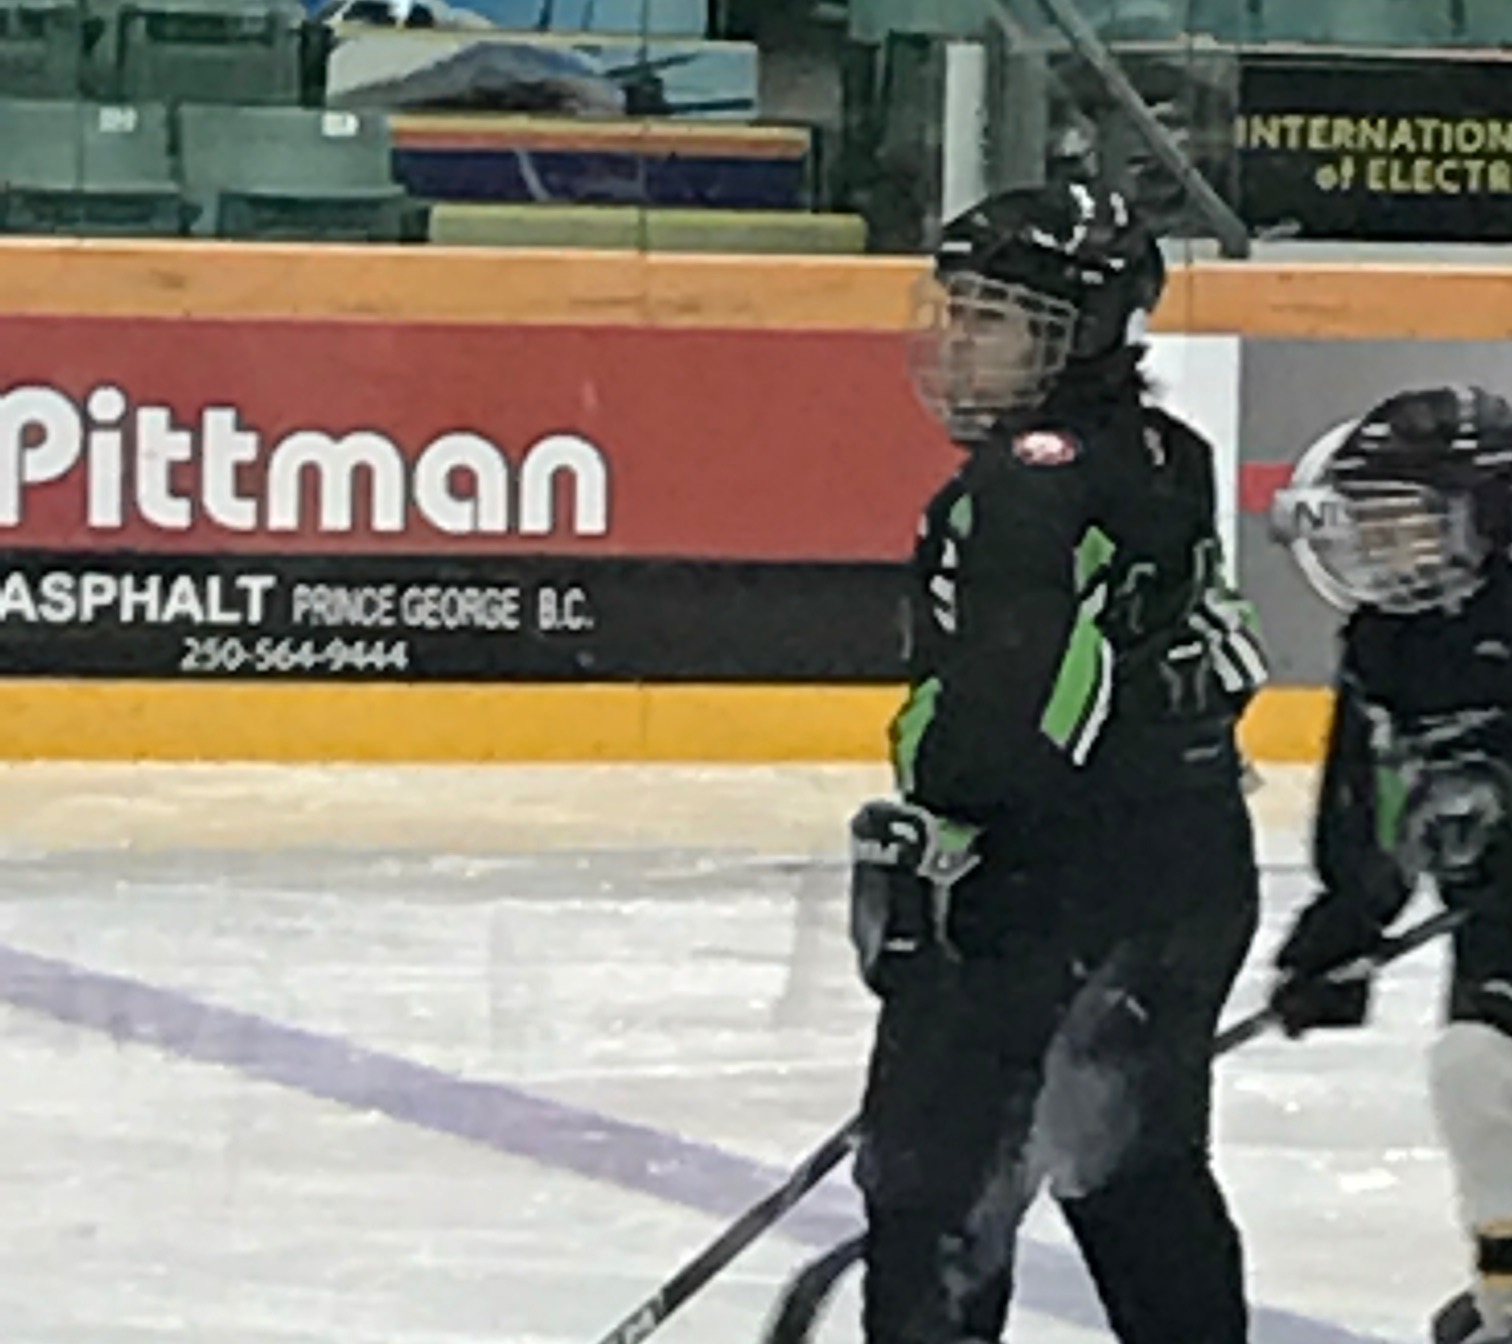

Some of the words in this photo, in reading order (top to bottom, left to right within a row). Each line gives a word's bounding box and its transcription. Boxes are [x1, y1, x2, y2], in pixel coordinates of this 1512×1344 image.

[1314, 160, 1355, 191] of
[0, 386, 608, 536] Pittman
[0, 573, 276, 625] ASPHALT
[291, 584, 397, 628] PRINCE
[402, 586, 521, 630] GEORGE
[537, 587, 595, 631] B.C.
[180, 636, 409, 672] 250-564-9444
